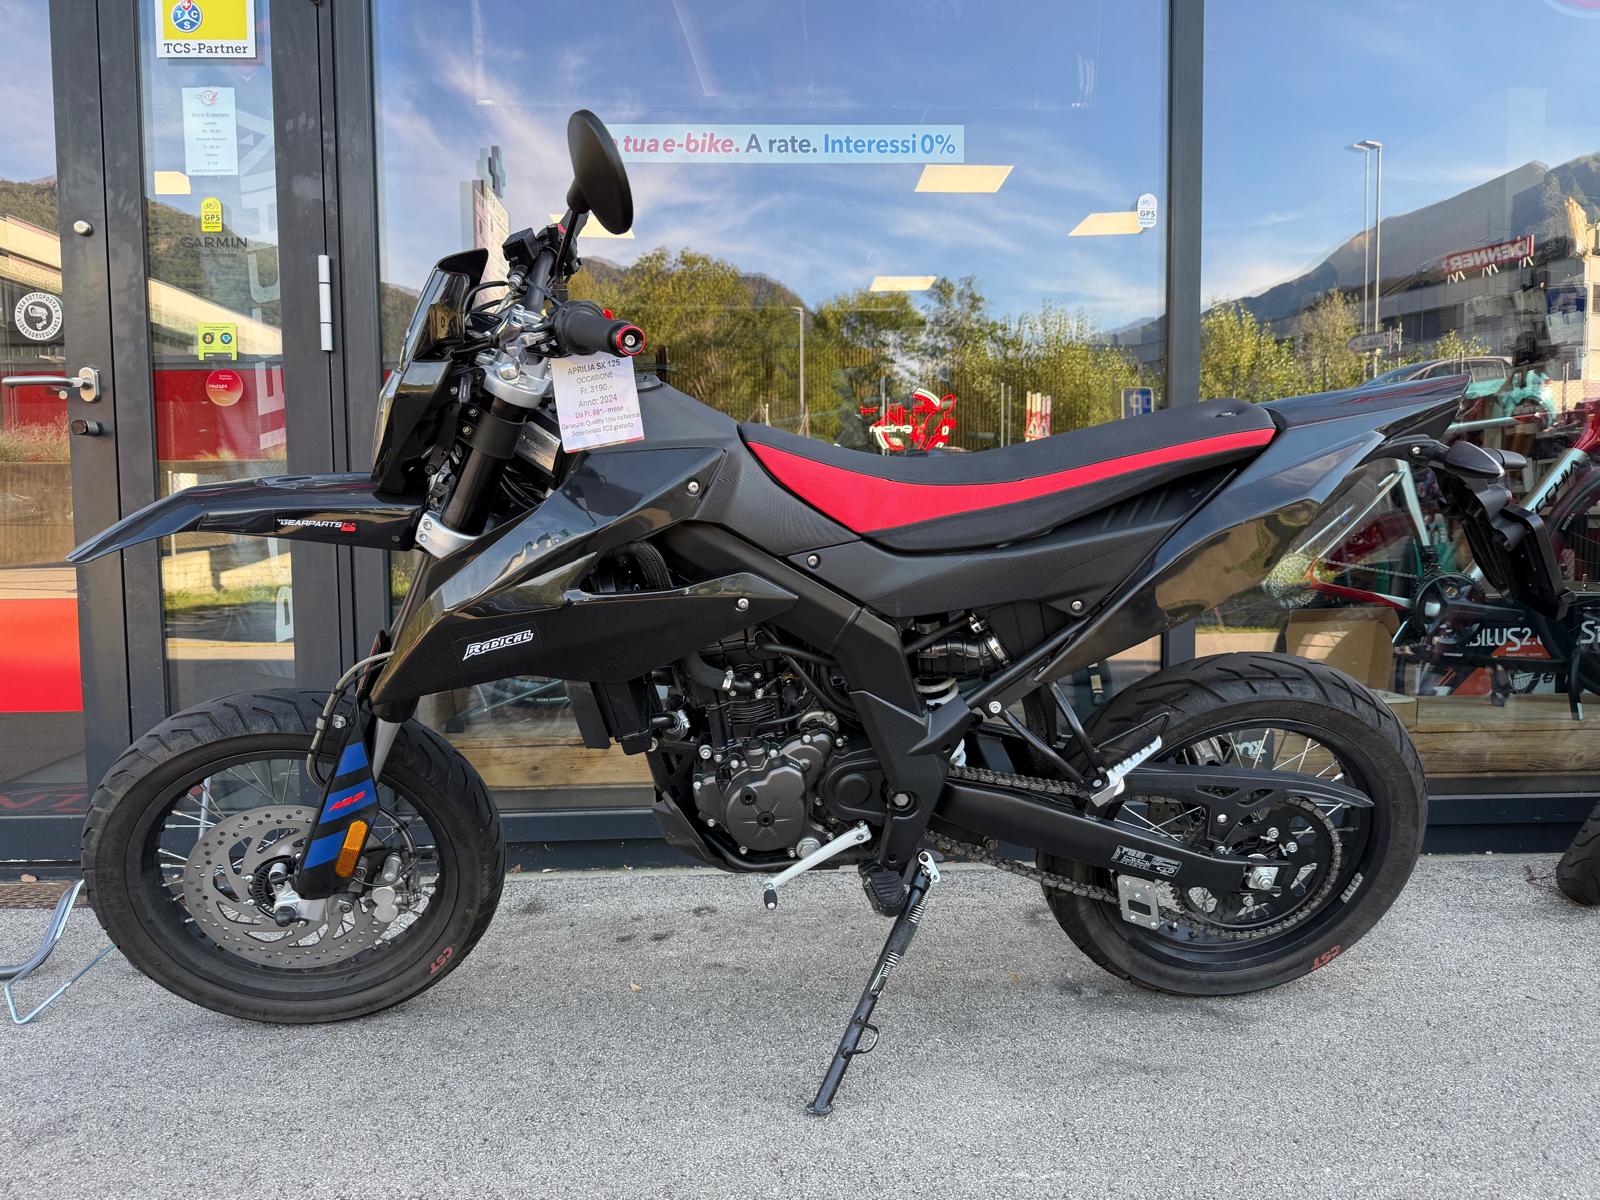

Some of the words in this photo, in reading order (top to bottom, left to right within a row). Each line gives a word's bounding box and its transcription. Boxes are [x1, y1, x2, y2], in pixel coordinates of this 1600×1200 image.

[163, 42, 248, 54] TCS-Partner
[623, 135, 659, 153] tua
[663, 132, 741, 154] e-bike.
[745, 133, 763, 154] A
[768, 134, 818, 154] rate.
[824, 133, 917, 154] Interessi
[921, 132, 956, 155] 0%
[204, 214, 221, 222] GPS
[1140, 210, 1156, 218] GPS
[180, 236, 248, 249] GARMIN
[567, 363, 596, 376] APRILIA
[608, 358, 621, 368] 125
[576, 372, 614, 384] OCCASIONE
[600, 393, 618, 404] 2024
[466, 631, 533, 657] RADICAL
[430, 946, 453, 974] CST
